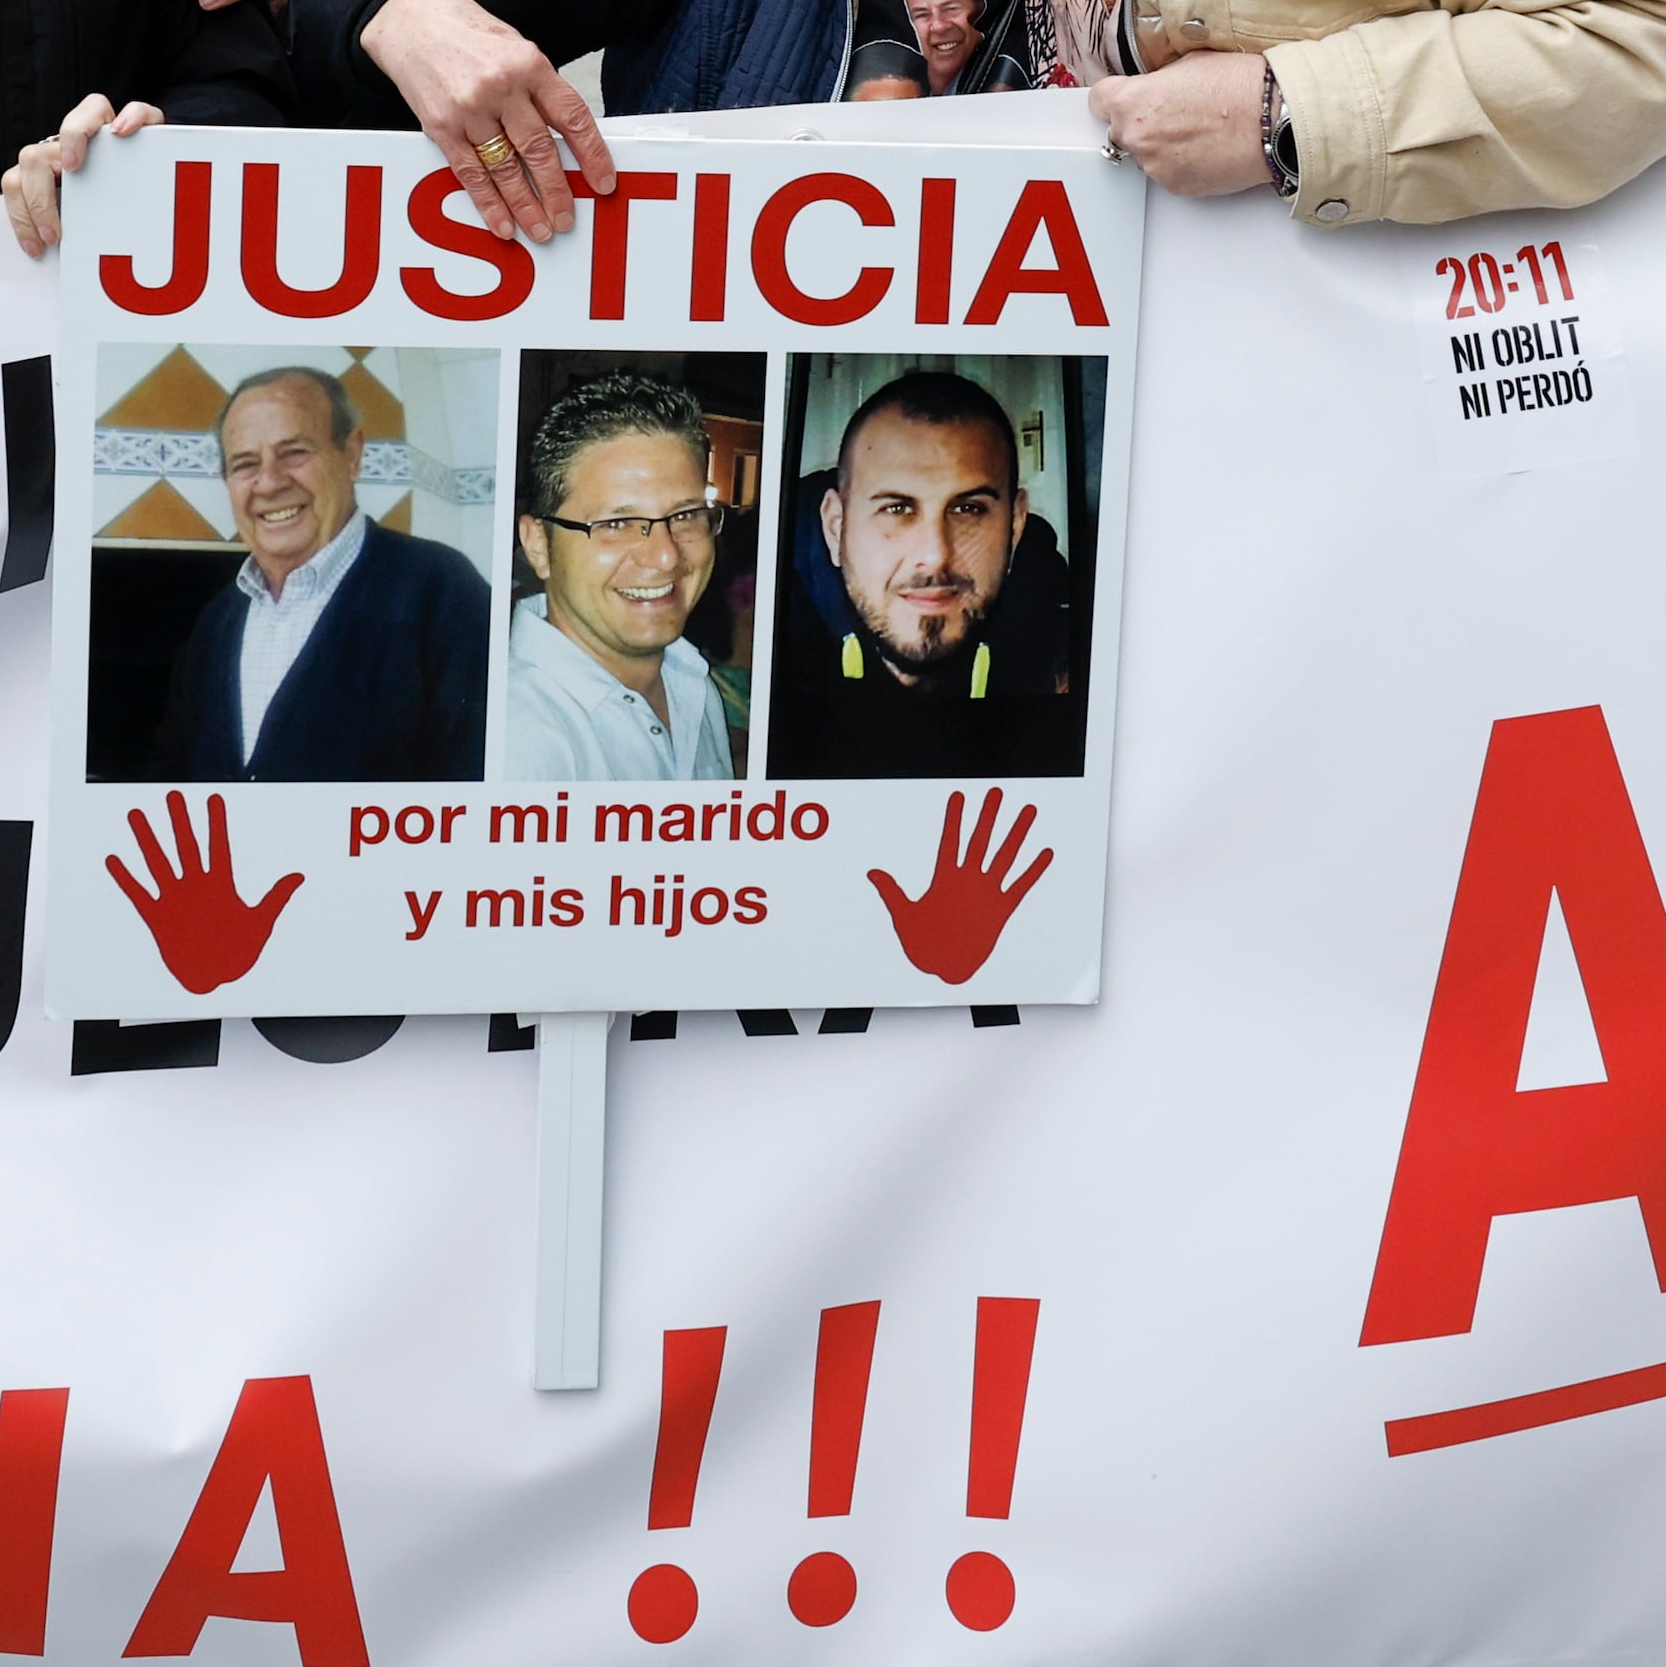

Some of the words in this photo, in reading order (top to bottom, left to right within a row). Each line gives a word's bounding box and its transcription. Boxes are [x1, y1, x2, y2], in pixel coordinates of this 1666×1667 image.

[98, 161, 1110, 328] JUSTICIA
[1435, 240, 1575, 320] 20:11
[1450, 332, 1486, 375] NI
[1491, 315, 1581, 368] OBLIT
[1458, 381, 1492, 420] NI
[1495, 359, 1594, 415] PERDÓ
[349, 804, 467, 857] por
[489, 791, 569, 844] mi
[594, 790, 830, 842] marido
[404, 890, 443, 941] y
[465, 875, 586, 928] mis
[609, 874, 769, 938] hijos
